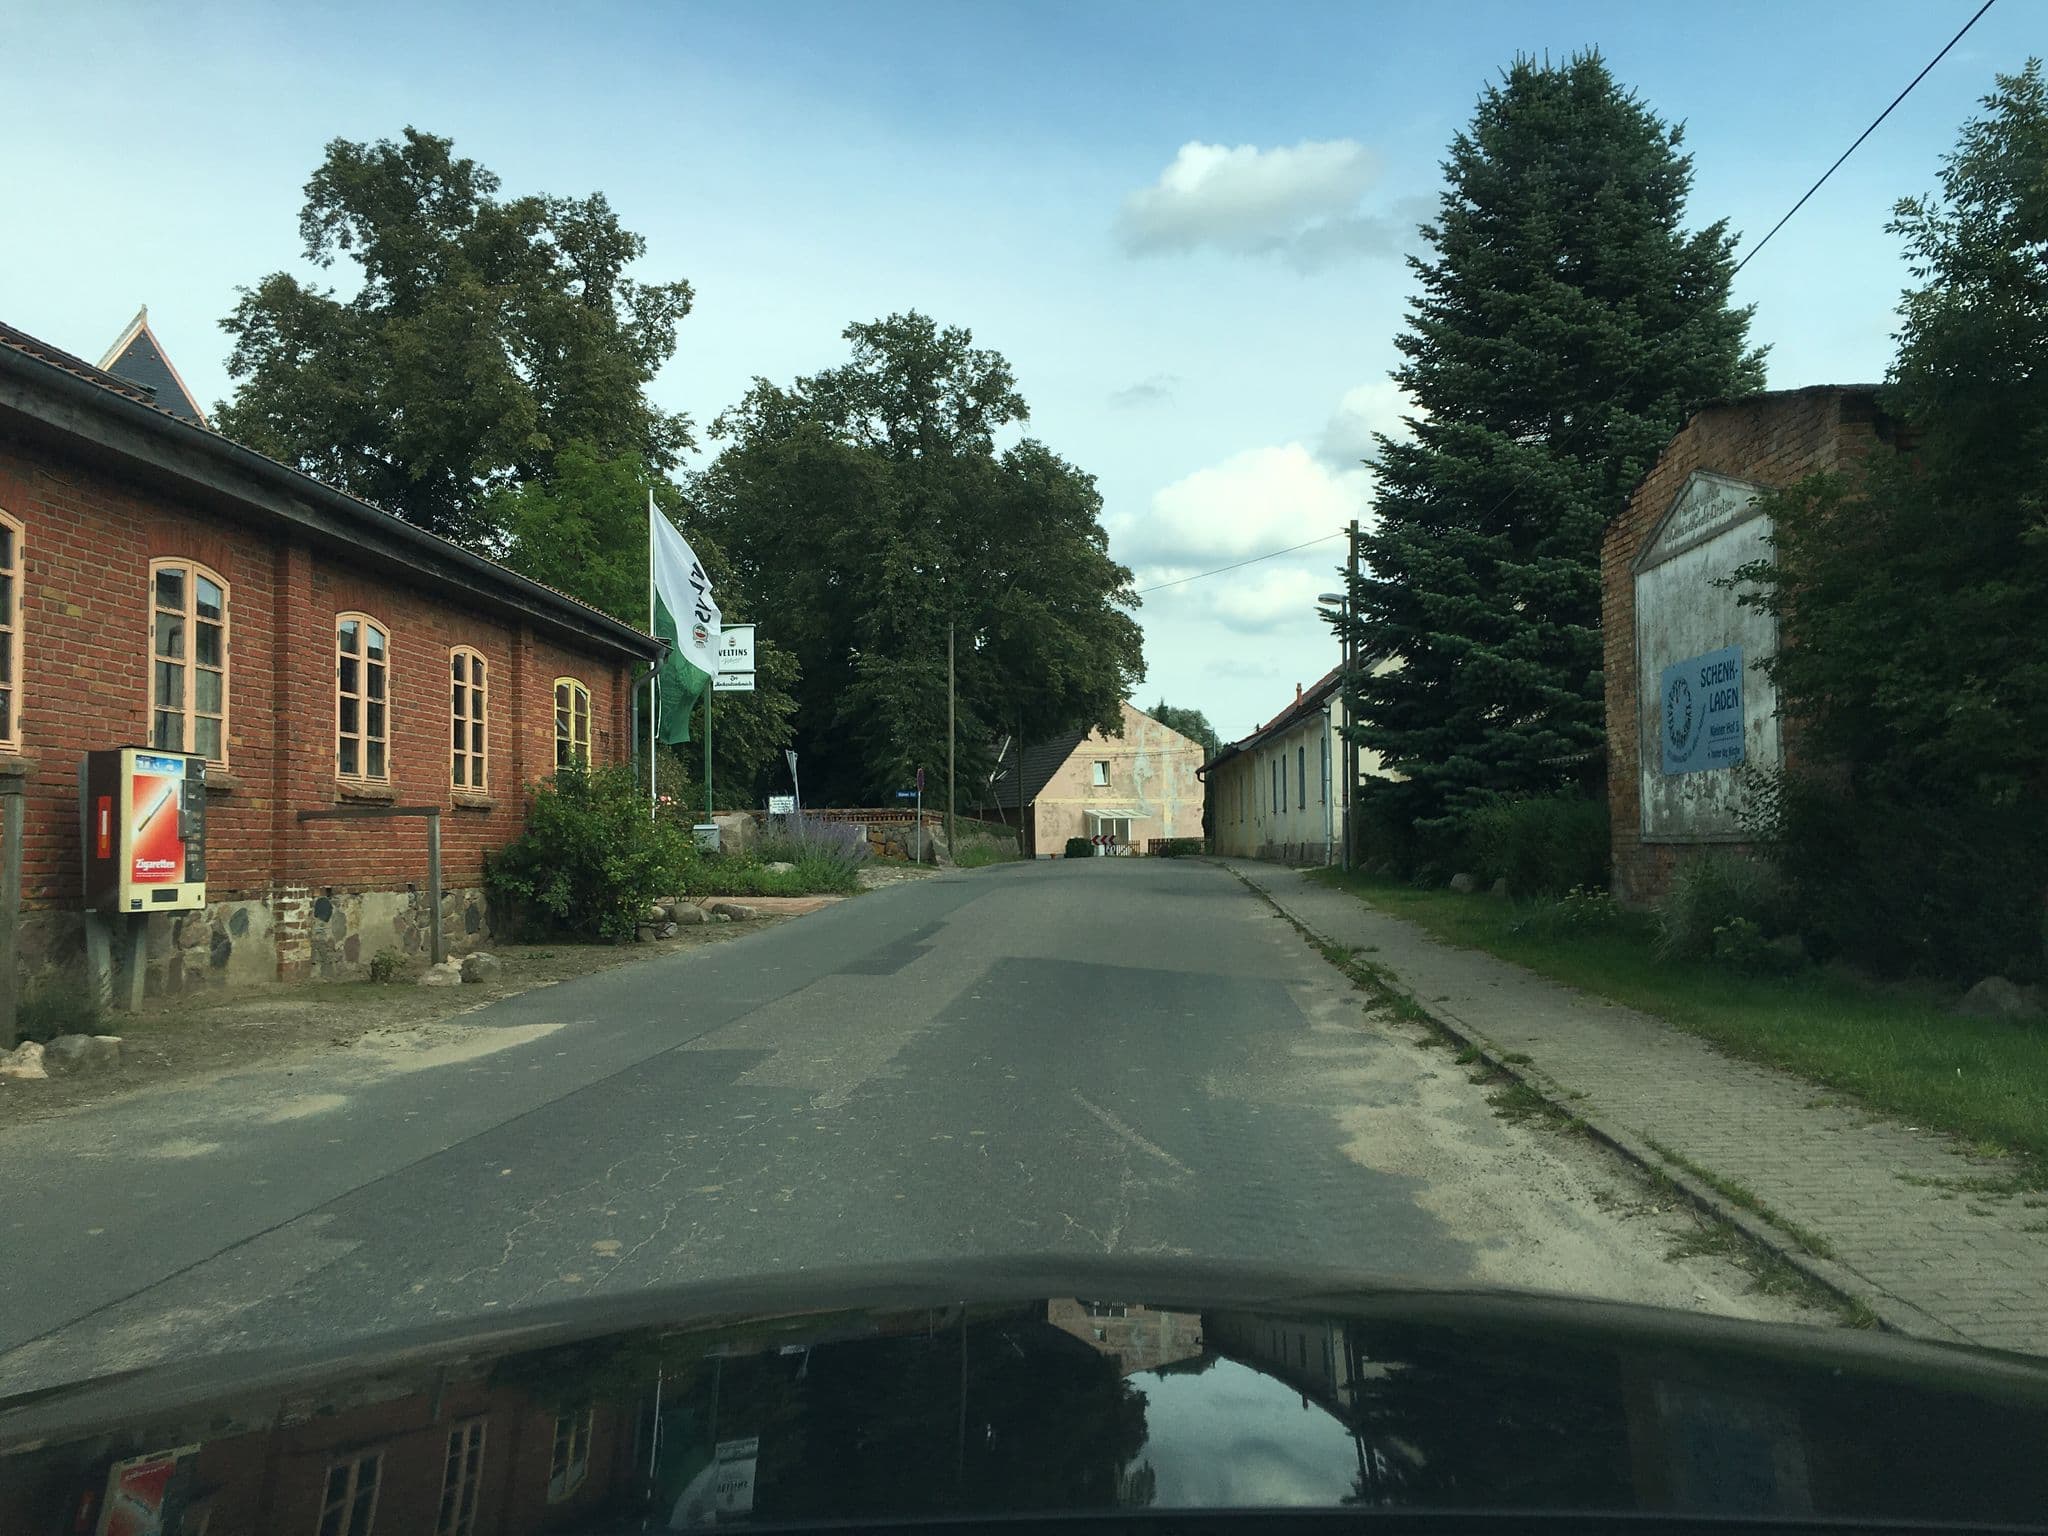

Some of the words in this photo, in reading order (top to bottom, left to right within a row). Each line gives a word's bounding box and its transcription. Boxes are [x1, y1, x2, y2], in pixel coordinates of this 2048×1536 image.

[718, 648, 748, 657] VELTINS
[1700, 660, 1739, 688] SCHENK-
[1709, 687, 1739, 713] LADEN
[135, 858, 176, 871] Zigaretten
